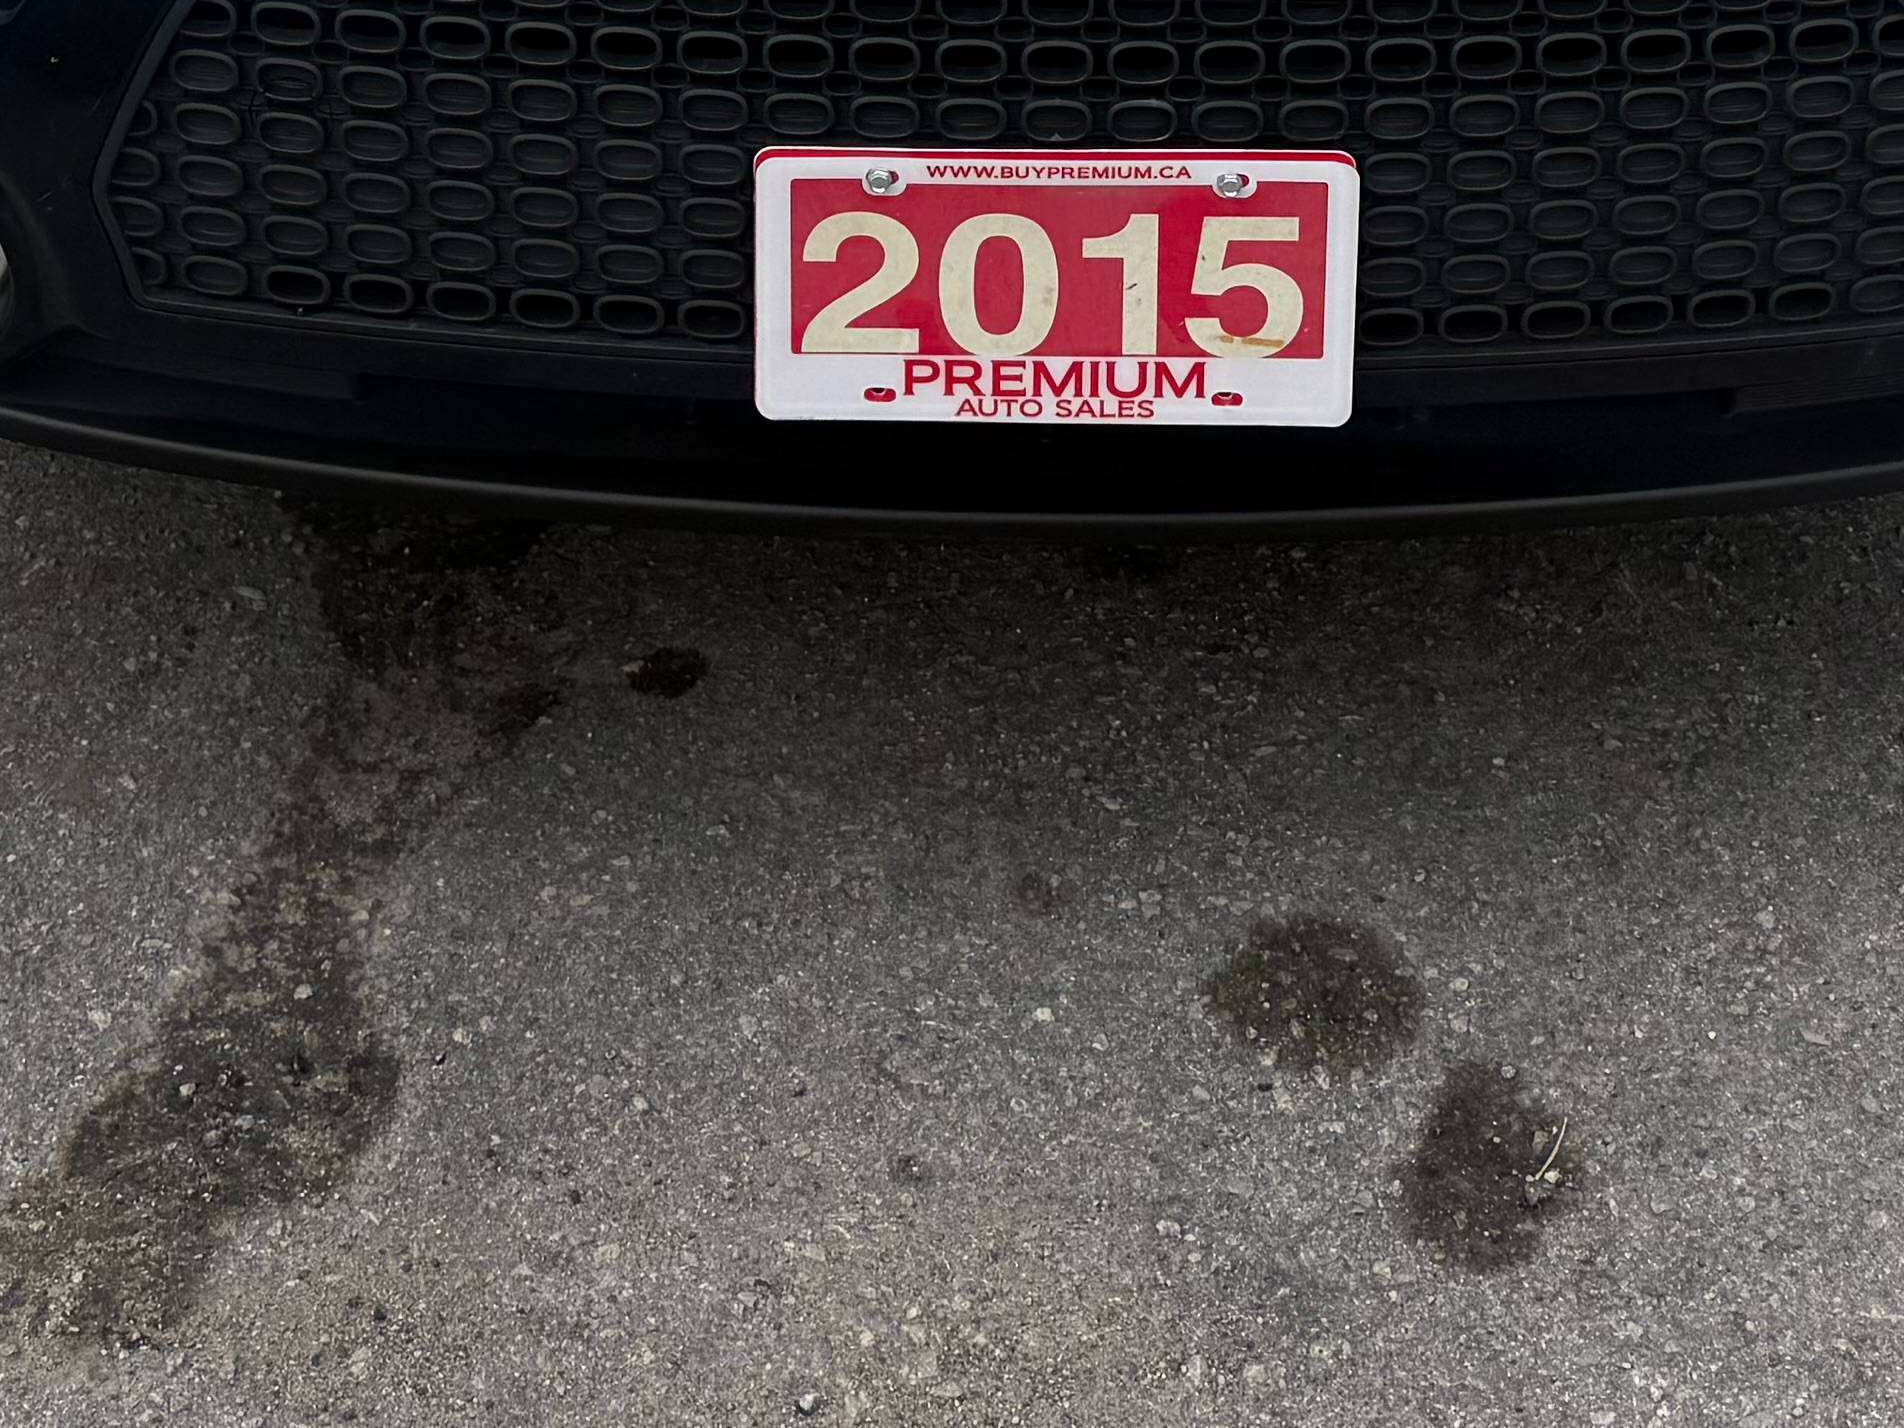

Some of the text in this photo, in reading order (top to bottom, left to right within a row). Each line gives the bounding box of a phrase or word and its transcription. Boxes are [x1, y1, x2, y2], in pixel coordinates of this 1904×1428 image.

[927, 164, 1192, 180] WWW.BUYPREMIUM.CA
[801, 211, 1305, 359] 2015
[903, 359, 1207, 400] PREMIUM
[955, 398, 1155, 419] AUTO SALES
